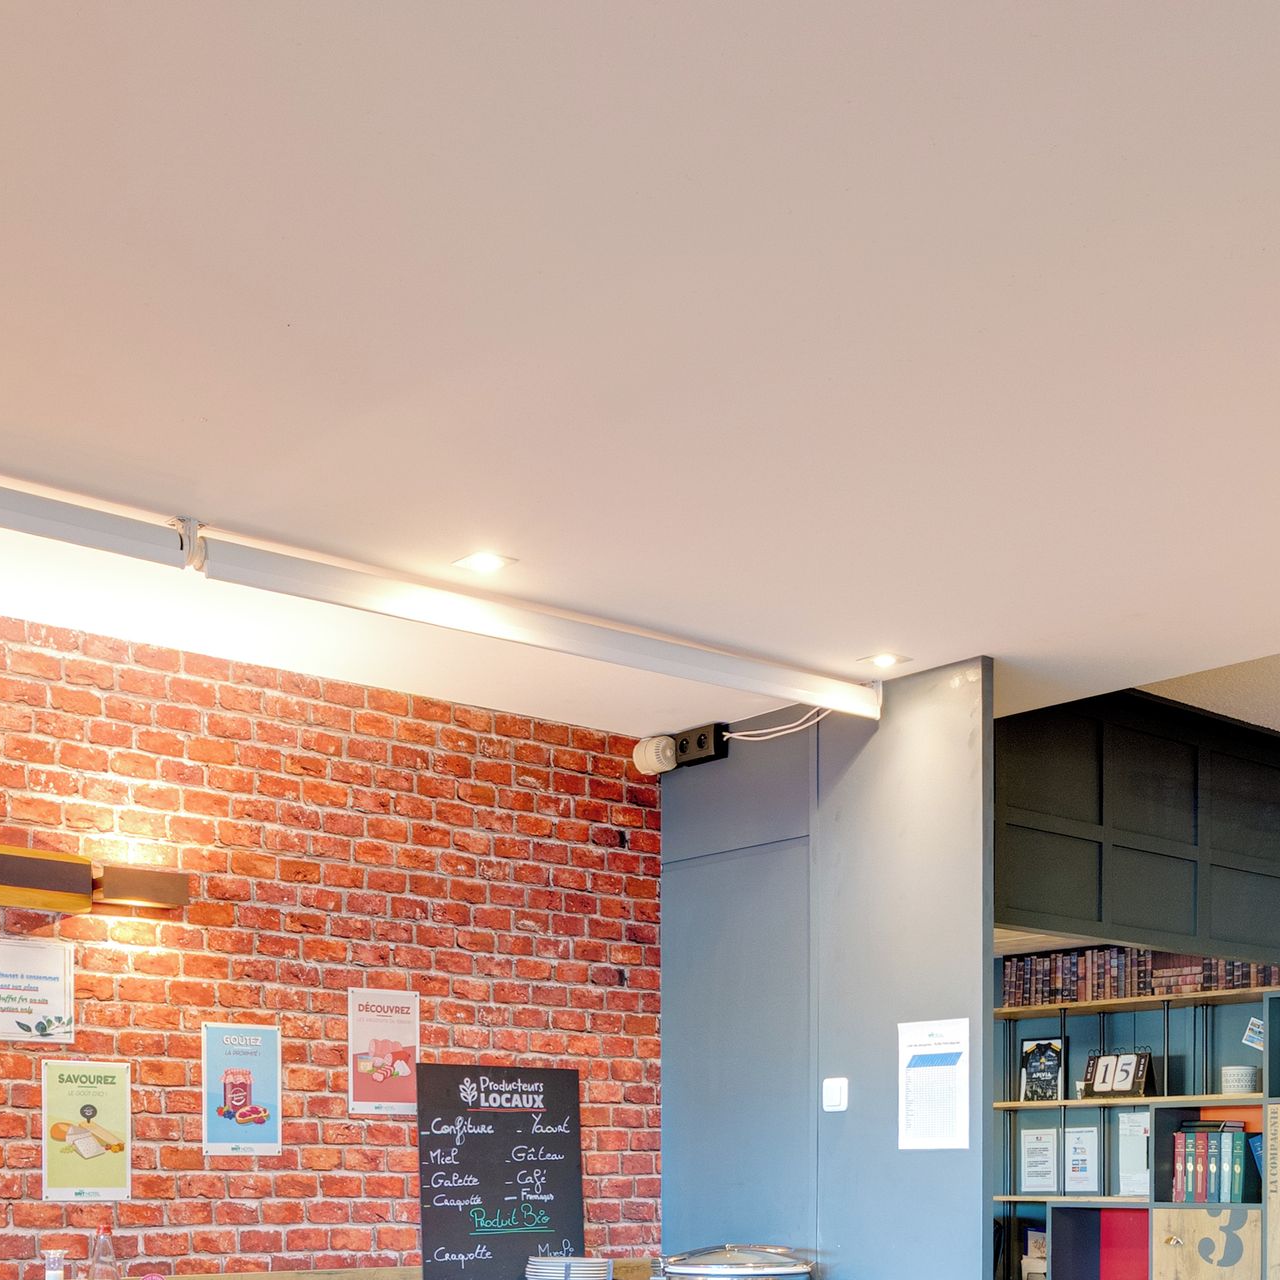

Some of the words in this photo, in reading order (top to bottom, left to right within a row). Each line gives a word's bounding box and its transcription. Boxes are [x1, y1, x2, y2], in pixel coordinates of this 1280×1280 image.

[17, 995, 28, 1004] for
[358, 1001, 411, 1015] DÉCOUVREZ
[223, 1034, 262, 1046] GOÛTEZ
[58, 1073, 116, 1085] SAVOUREZ
[480, 1076, 544, 1093] Producteurs
[479, 1093, 545, 1108] LOCAUX
[431, 1115, 495, 1145] Confiture
[531, 1113, 570, 1134] Yaourt
[1270, 1106, 1278, 1177] COMPAGNIE
[429, 1147, 459, 1165] Miel
[511, 1145, 565, 1162] Gâteau
[431, 1171, 480, 1188] Galette
[517, 1168, 547, 1193] Café
[1270, 1180, 1278, 1194] LA
[433, 1193, 483, 1212] Craquotte
[521, 1188, 554, 1202] Fromages
[469, 1207, 519, 1229] Produit
[520, 1203, 551, 1227] Bio
[1197, 1208, 1249, 1267] 3
[433, 1244, 493, 1269] Craquotte
